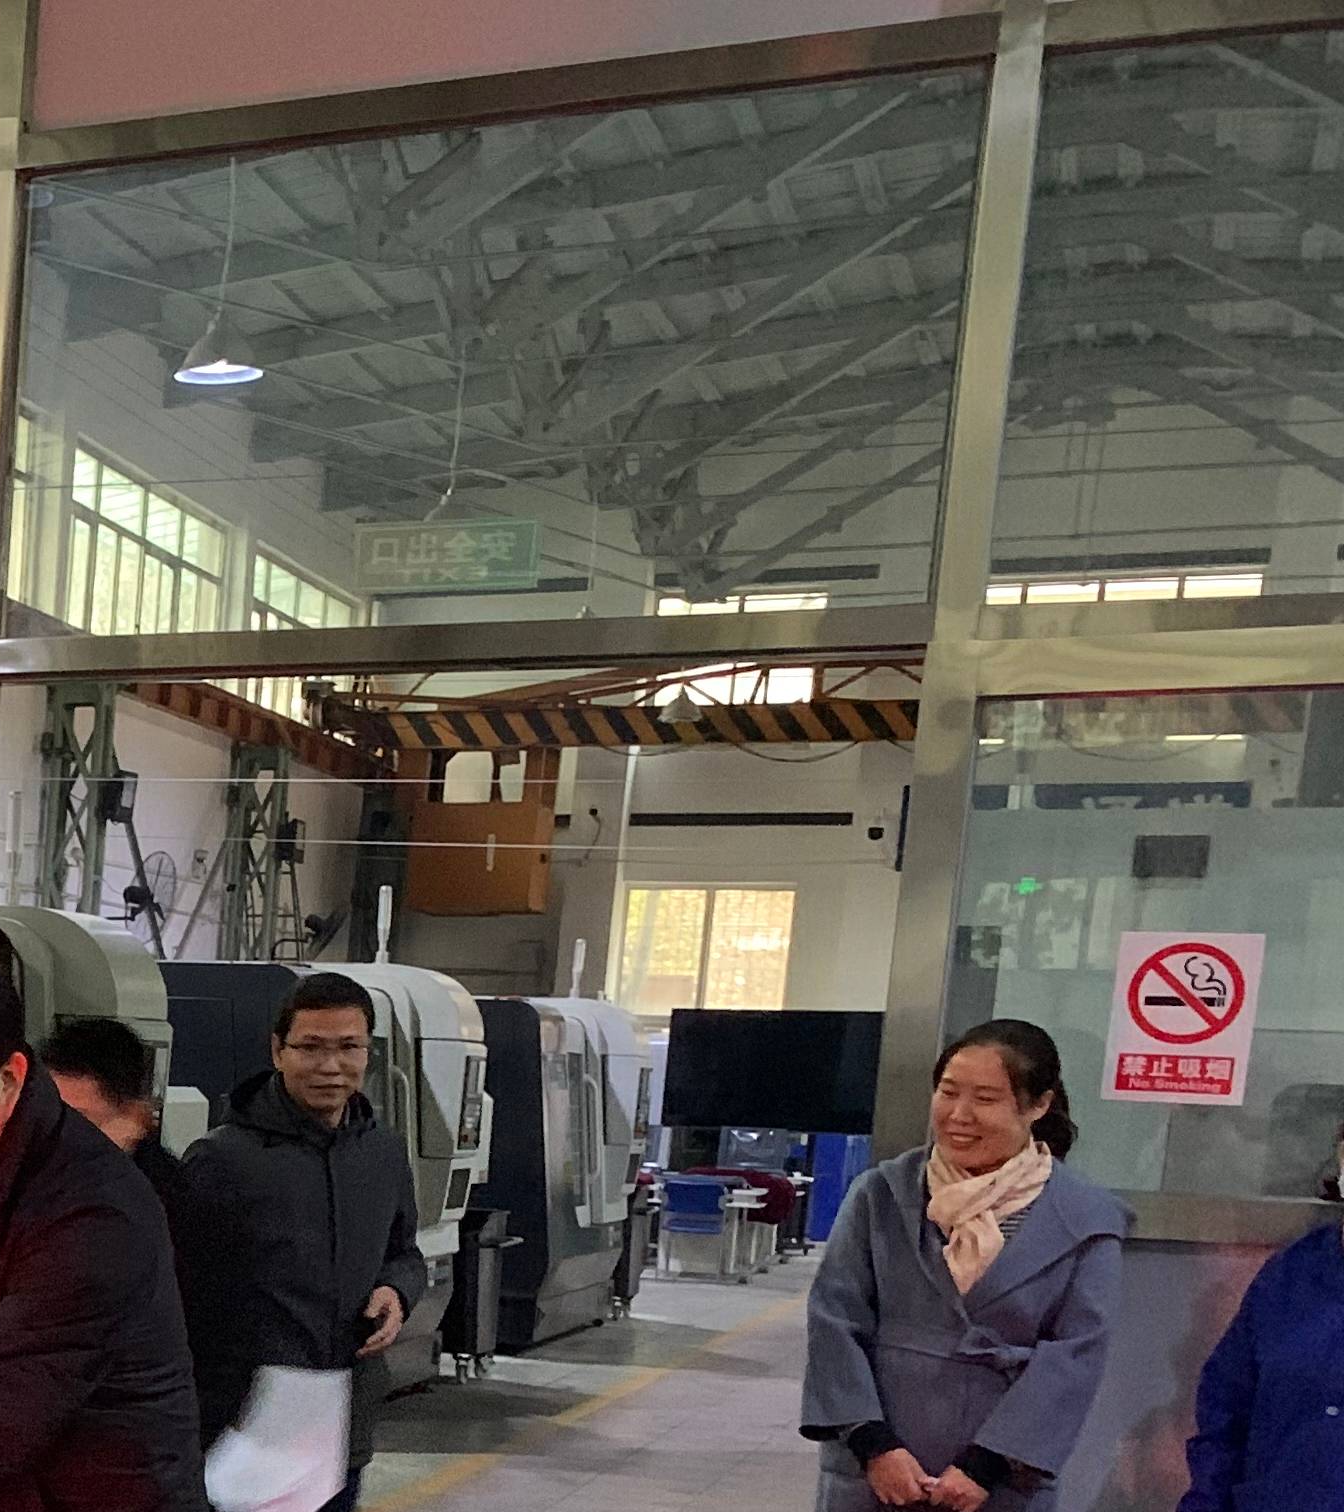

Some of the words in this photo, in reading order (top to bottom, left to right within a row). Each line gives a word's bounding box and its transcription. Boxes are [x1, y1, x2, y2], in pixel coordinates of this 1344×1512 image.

[1120, 1055, 1231, 1080] 禁止吸烟
[1128, 1078, 1151, 1089] No
